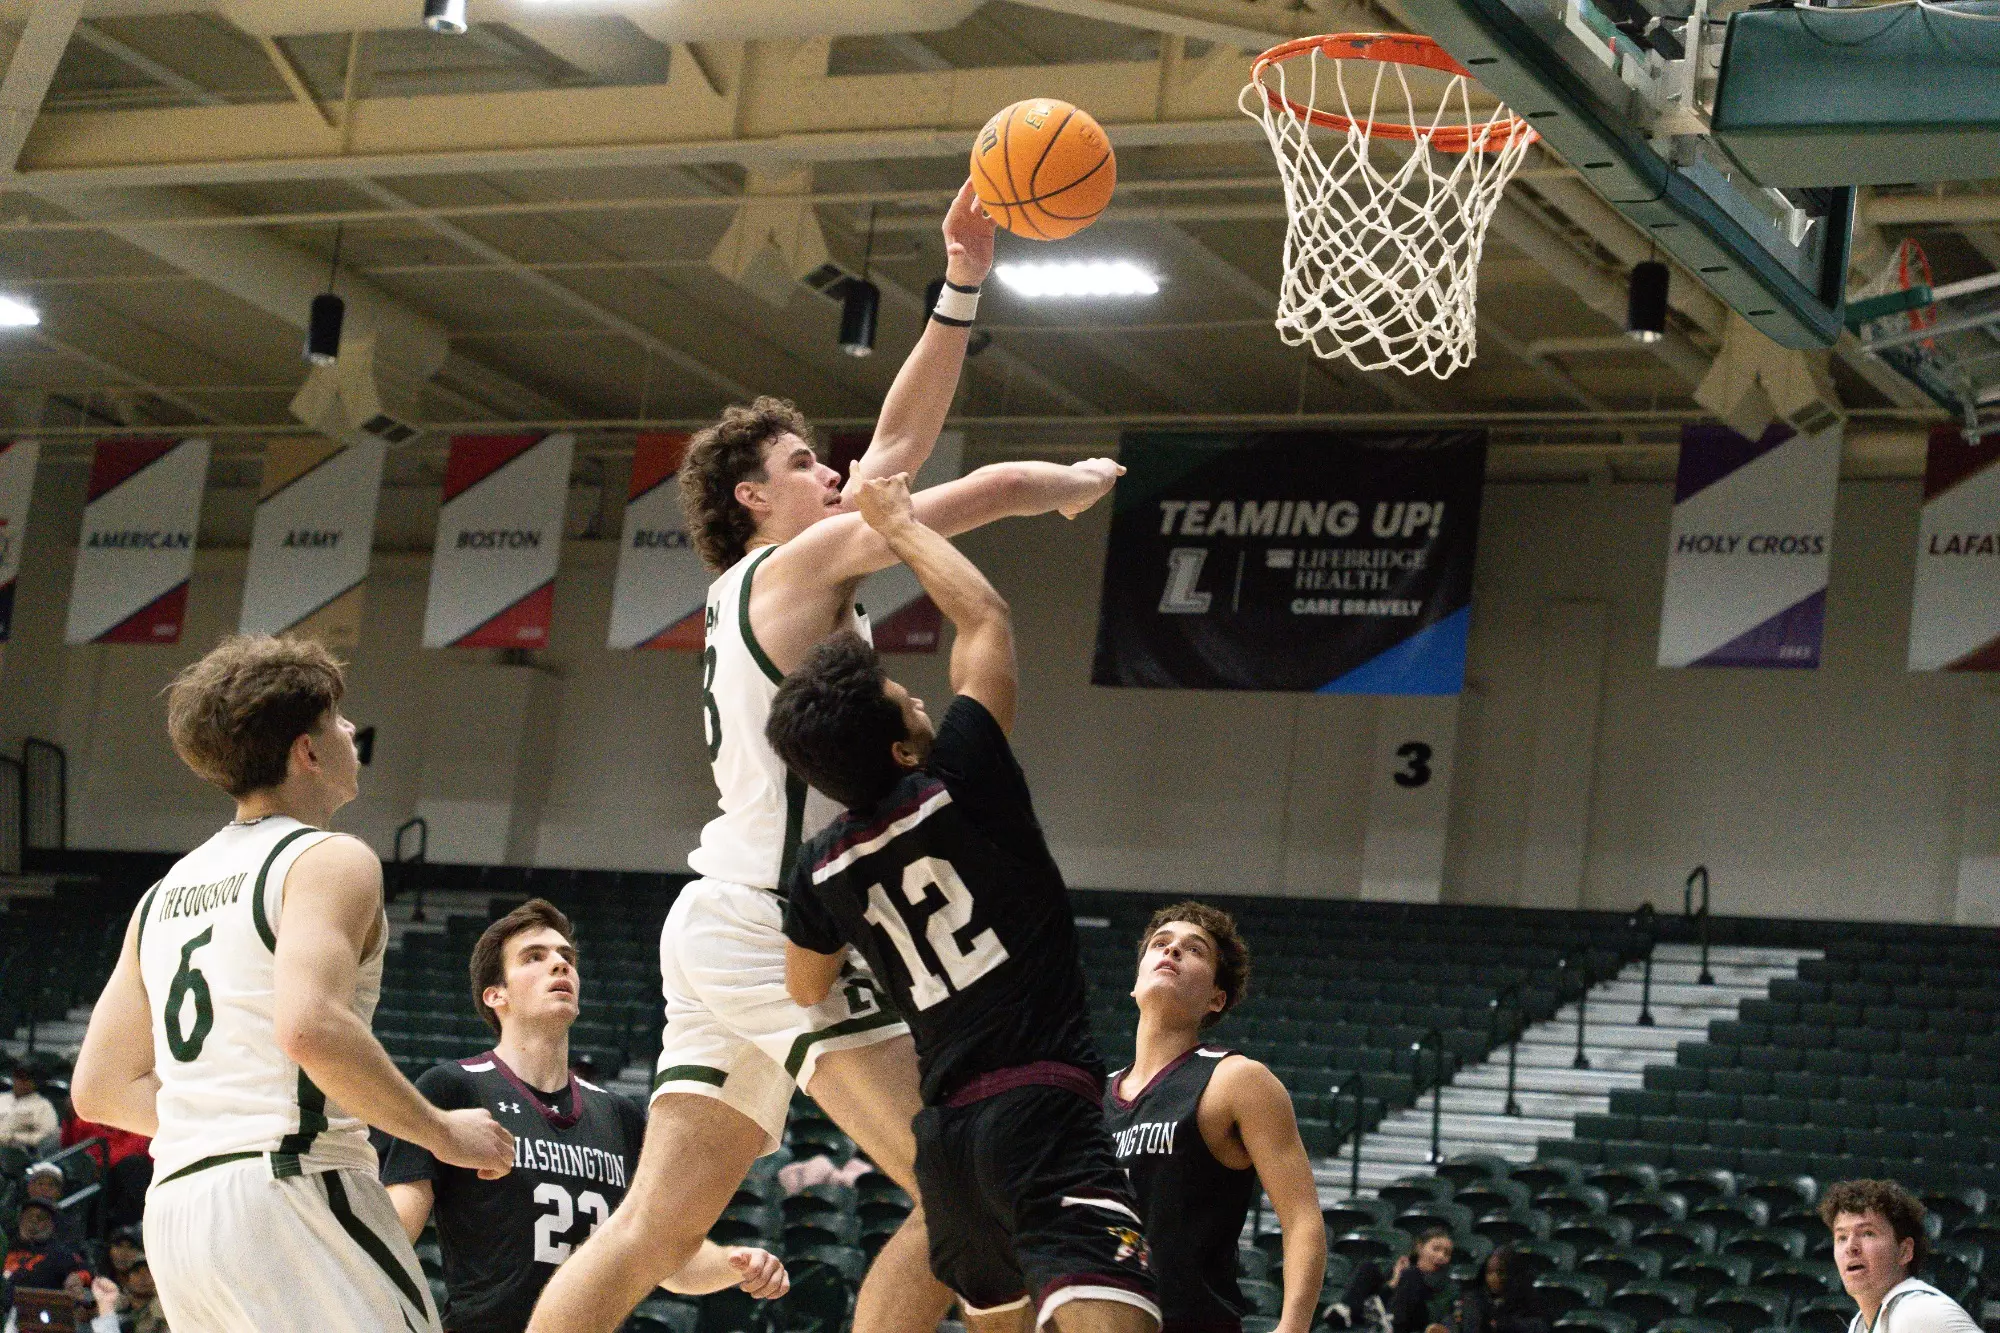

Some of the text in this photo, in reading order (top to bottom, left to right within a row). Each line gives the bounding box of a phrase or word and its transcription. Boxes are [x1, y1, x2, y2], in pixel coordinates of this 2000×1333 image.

[1160, 500, 1445, 538] TEAMING UP!
[88, 530, 191, 549] AMERICAN
[283, 530, 343, 549] ARMY
[456, 530, 541, 550] BOSTON
[1677, 534, 1825, 555] HOLY CROSS
[1157, 547, 1213, 613] L
[1295, 569, 1389, 590] HEALTH
[1290, 599, 1340, 616] CARE
[1394, 742, 1431, 788] 3
[864, 855, 1010, 1011] 12
[164, 923, 215, 1063] 6
